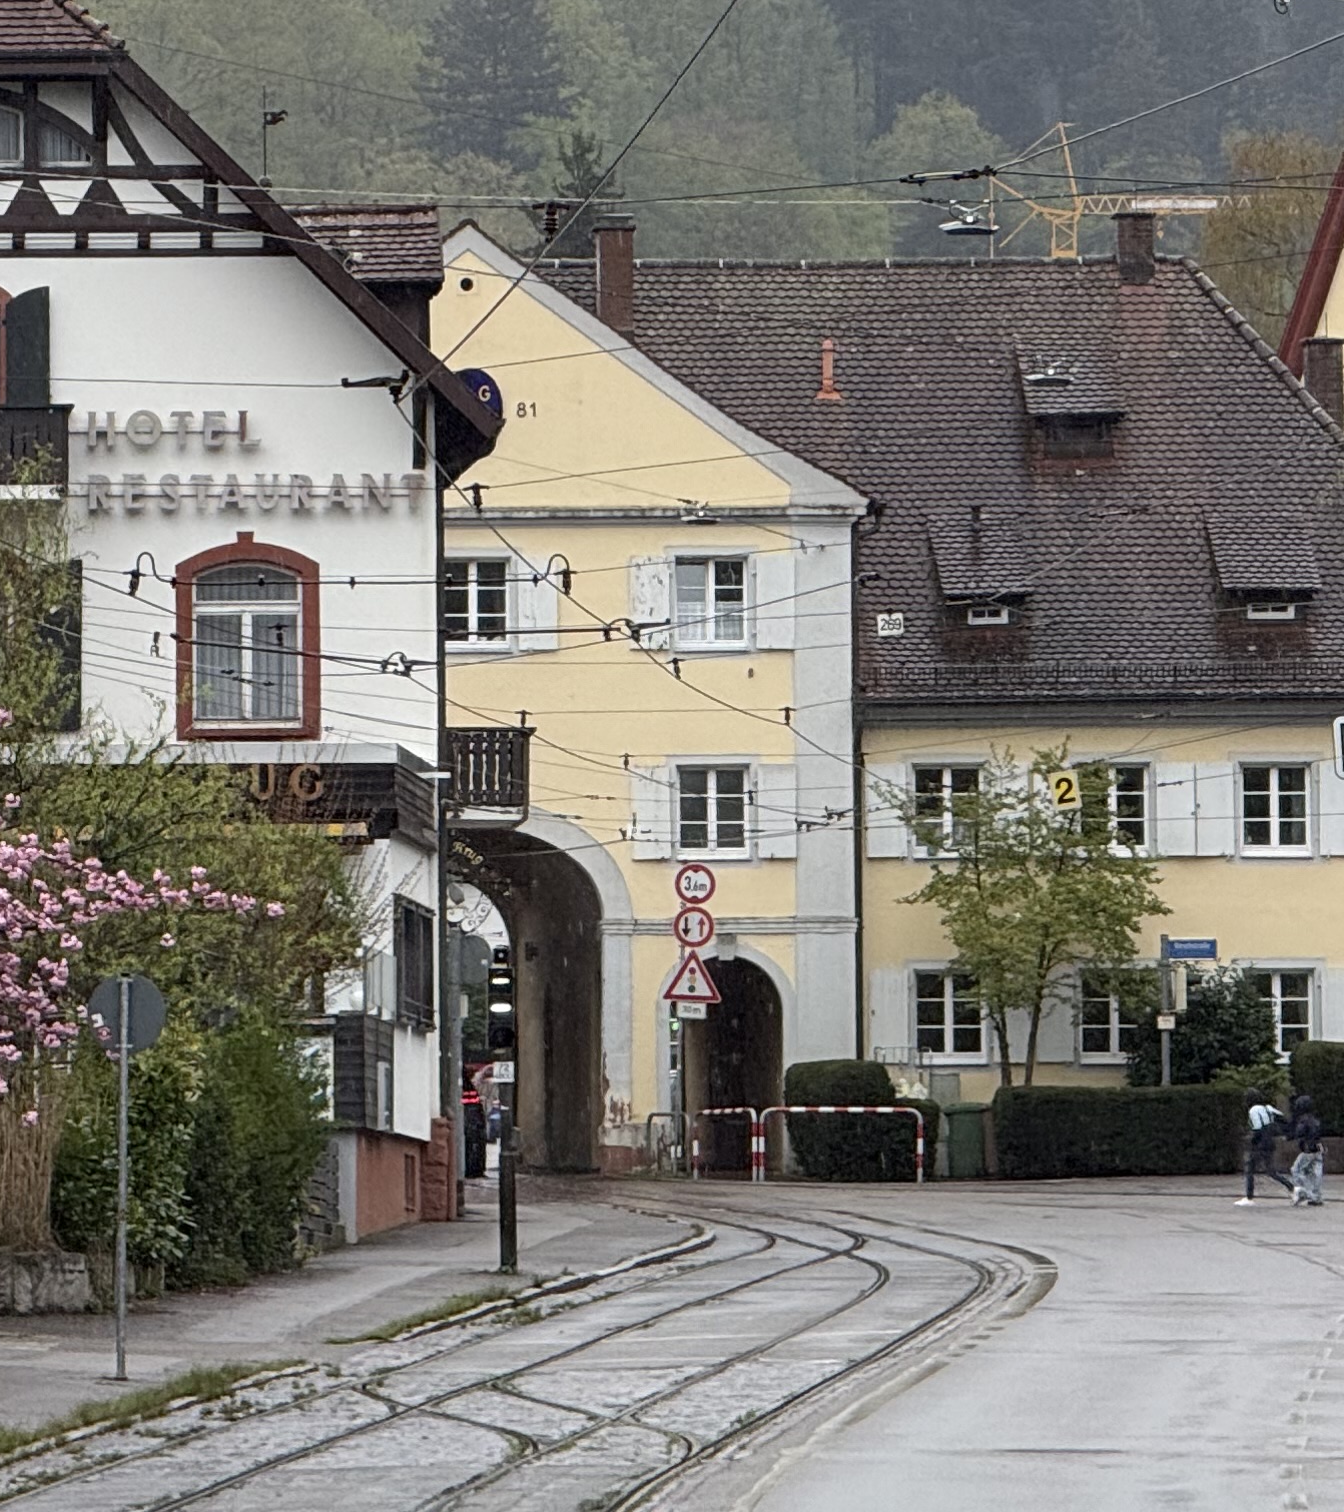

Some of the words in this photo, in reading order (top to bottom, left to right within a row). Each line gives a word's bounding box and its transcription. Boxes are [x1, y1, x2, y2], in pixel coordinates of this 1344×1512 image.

[516, 402, 537, 418] 81
[86, 409, 261, 448] HOTEL
[86, 473, 426, 511] RESTAURANT
[1055, 777, 1076, 805] 2
